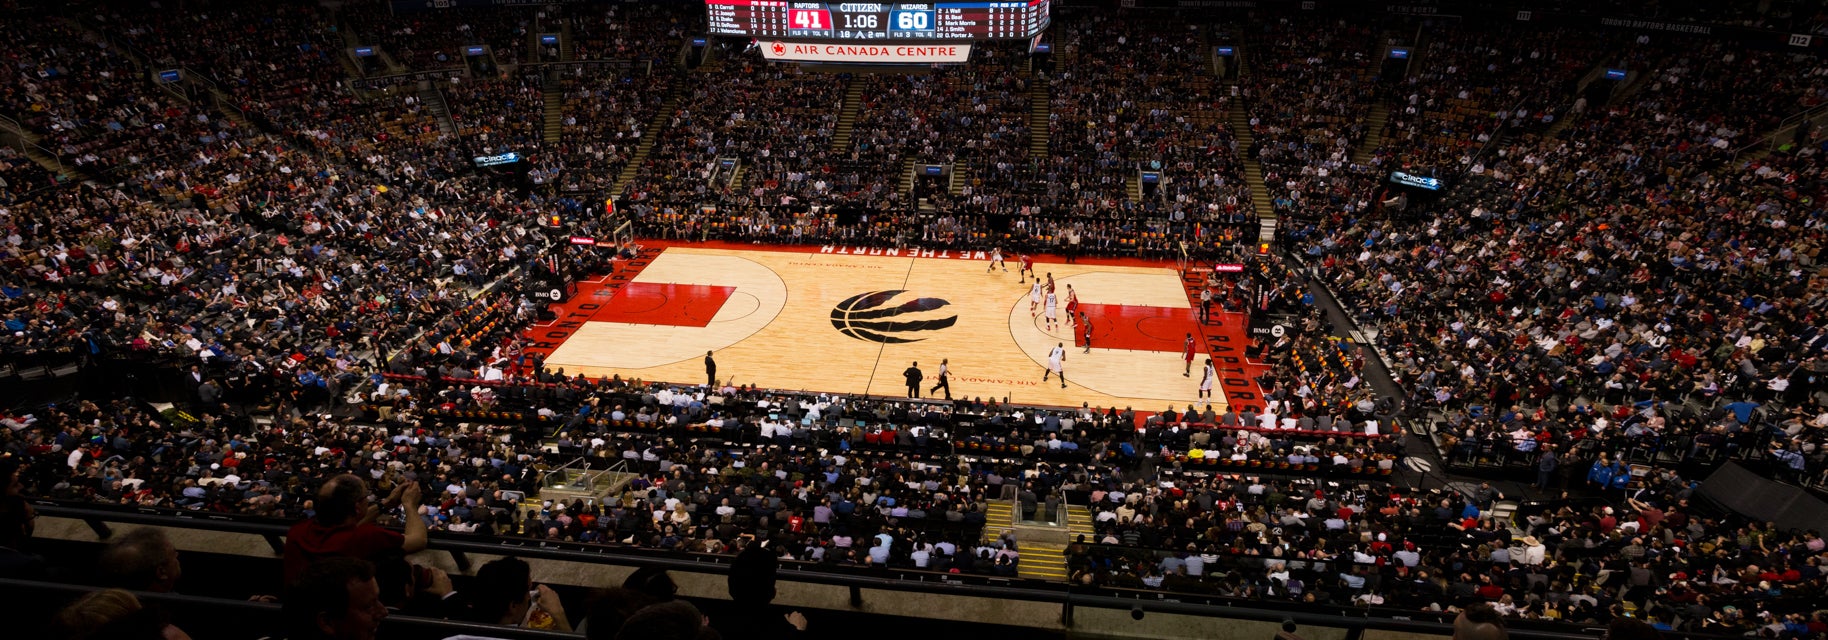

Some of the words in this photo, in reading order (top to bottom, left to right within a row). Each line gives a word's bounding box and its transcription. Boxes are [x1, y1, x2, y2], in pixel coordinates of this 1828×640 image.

[840, 3, 881, 12] CITIZEN
[796, 11, 821, 28] 41
[845, 15, 877, 28] 1:06
[899, 12, 927, 28] 60
[1601, 17, 1631, 27] TORONTO
[1632, 20, 1665, 30] RAPTORS
[1666, 24, 1712, 34] BASKETBALL
[1792, 36, 1808, 44] 112
[795, 45, 819, 55] AIR
[826, 46, 890, 56] CANADA
[897, 46, 957, 56] CENTRE
[820, 245, 899, 256] NORTH
[907, 248, 950, 258] THE
[959, 250, 986, 260] WE
